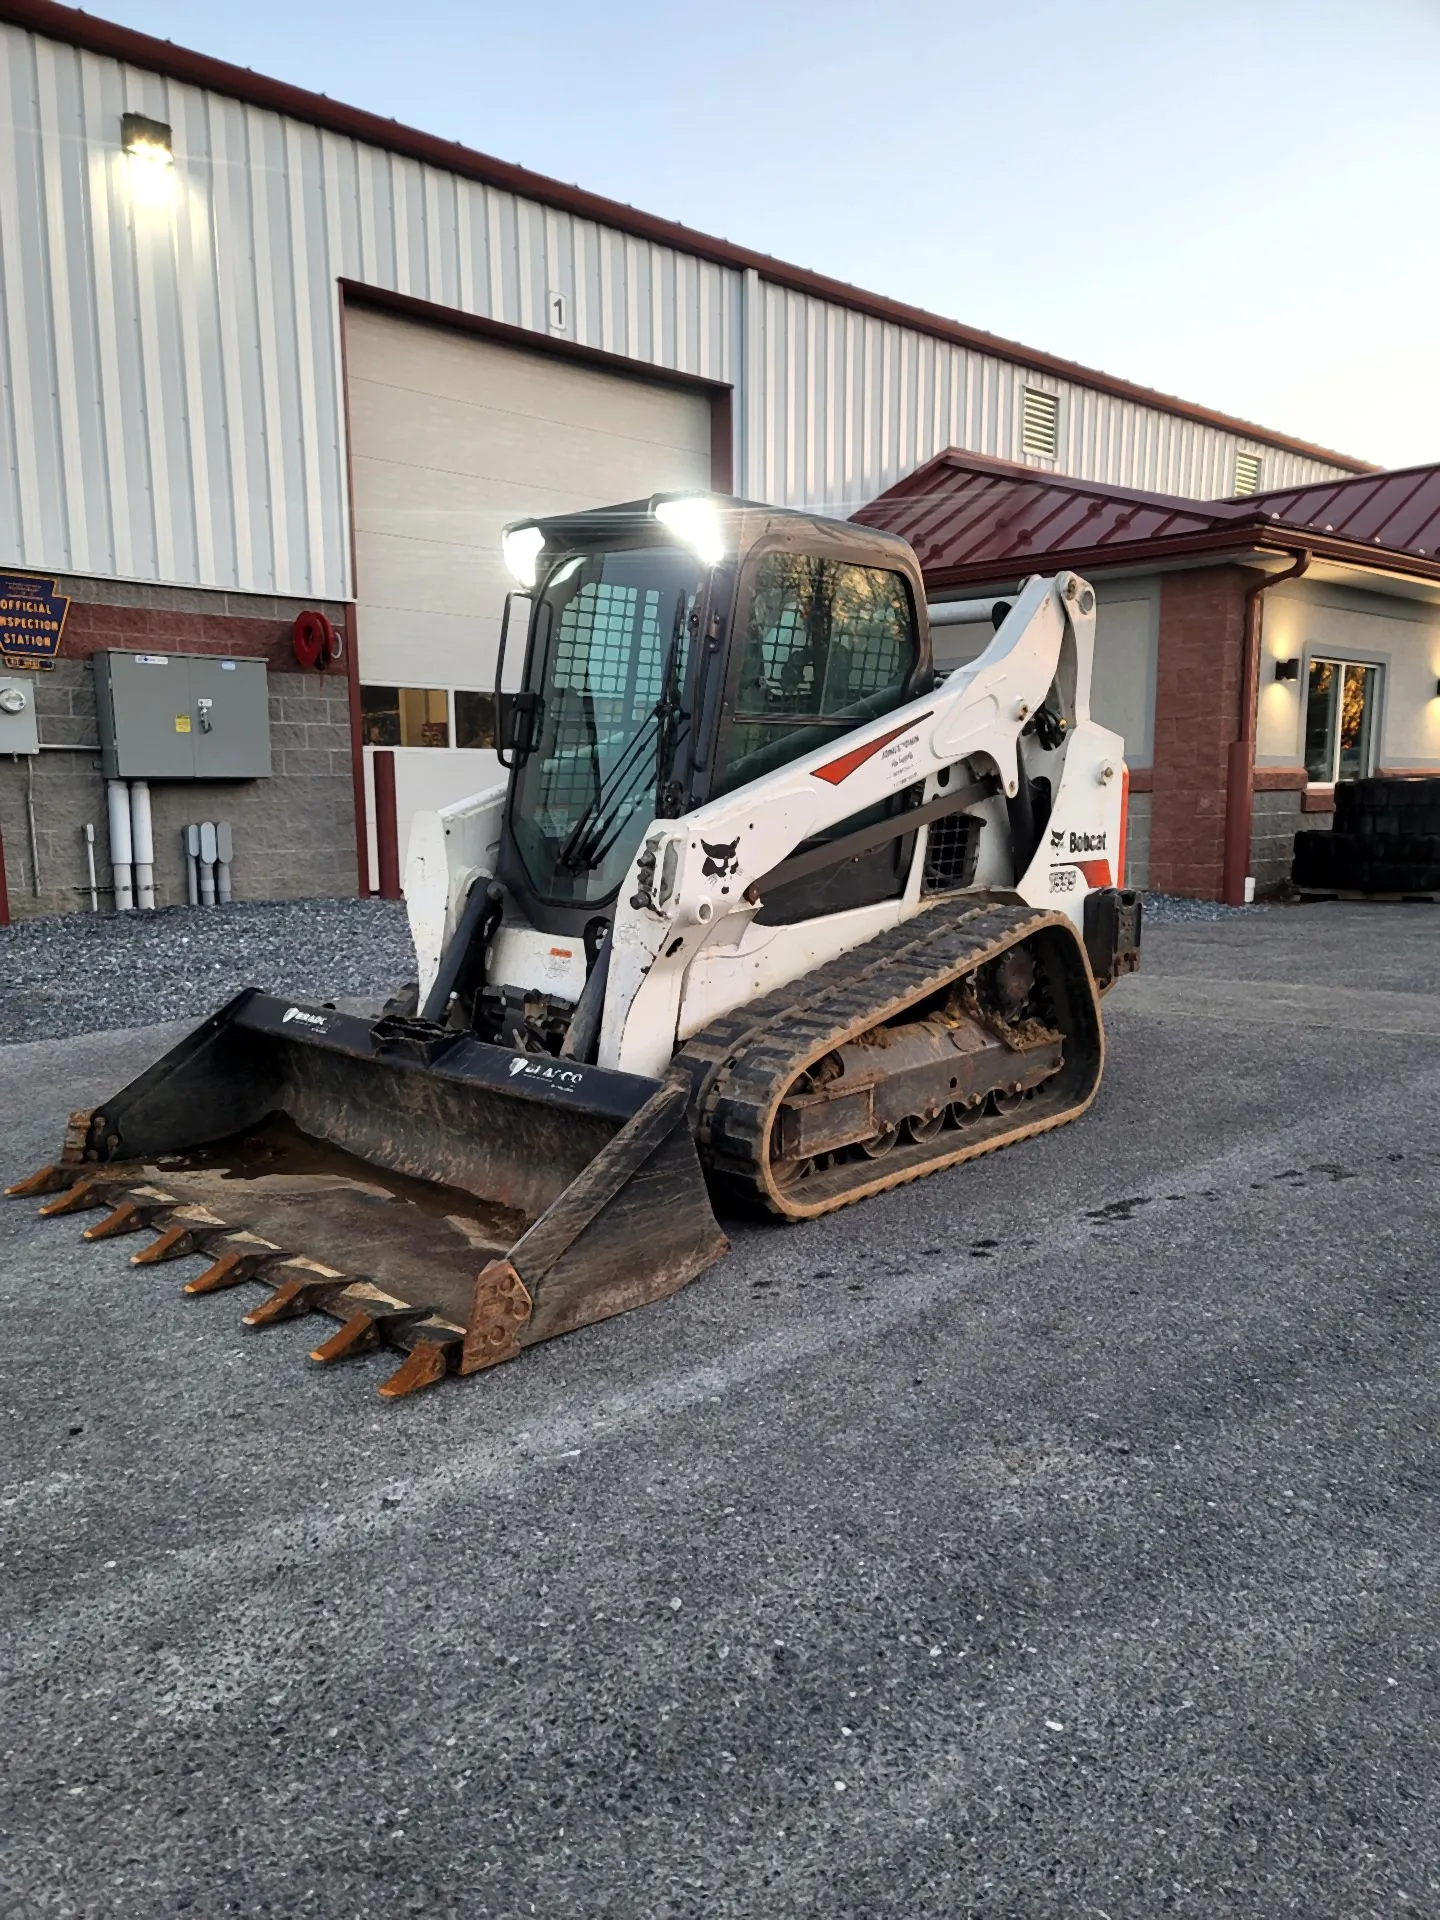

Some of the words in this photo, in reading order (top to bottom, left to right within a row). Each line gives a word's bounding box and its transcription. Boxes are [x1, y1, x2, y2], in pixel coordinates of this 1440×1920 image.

[553, 298, 562, 325] 1
[0, 599, 51, 615] OFFICIAL
[0, 615, 58, 631] NSPECTION
[3, 632, 51, 647] STATION
[1069, 831, 1106, 853] Bobcat
